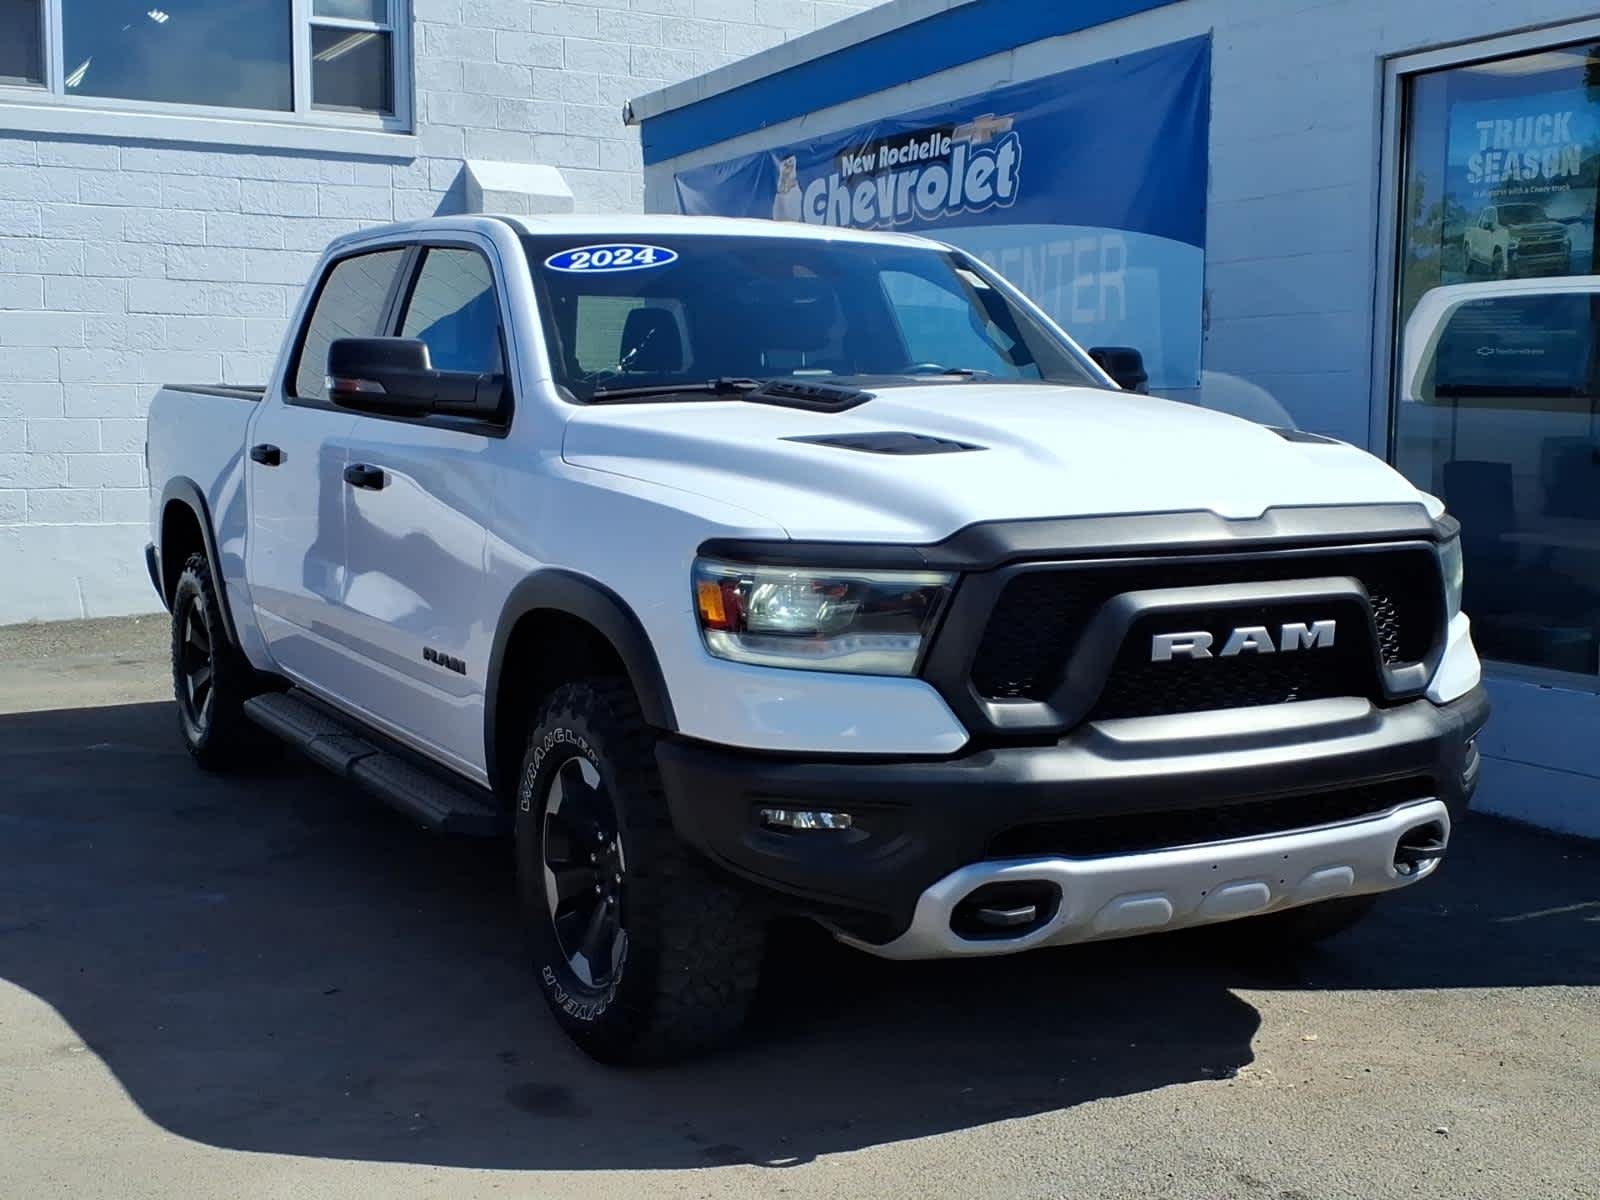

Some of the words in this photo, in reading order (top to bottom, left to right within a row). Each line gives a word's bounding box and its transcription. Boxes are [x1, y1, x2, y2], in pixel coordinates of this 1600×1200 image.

[1475, 112, 1573, 150] TRUCK
[841, 152, 876, 177] New
[879, 132, 951, 168] Rochelle
[1466, 144, 1582, 183] SEASON
[803, 140, 1015, 227] Chevrolet
[569, 247, 657, 269] 2024
[1152, 620, 1336, 661] RAM
[423, 646, 466, 676] RAM
